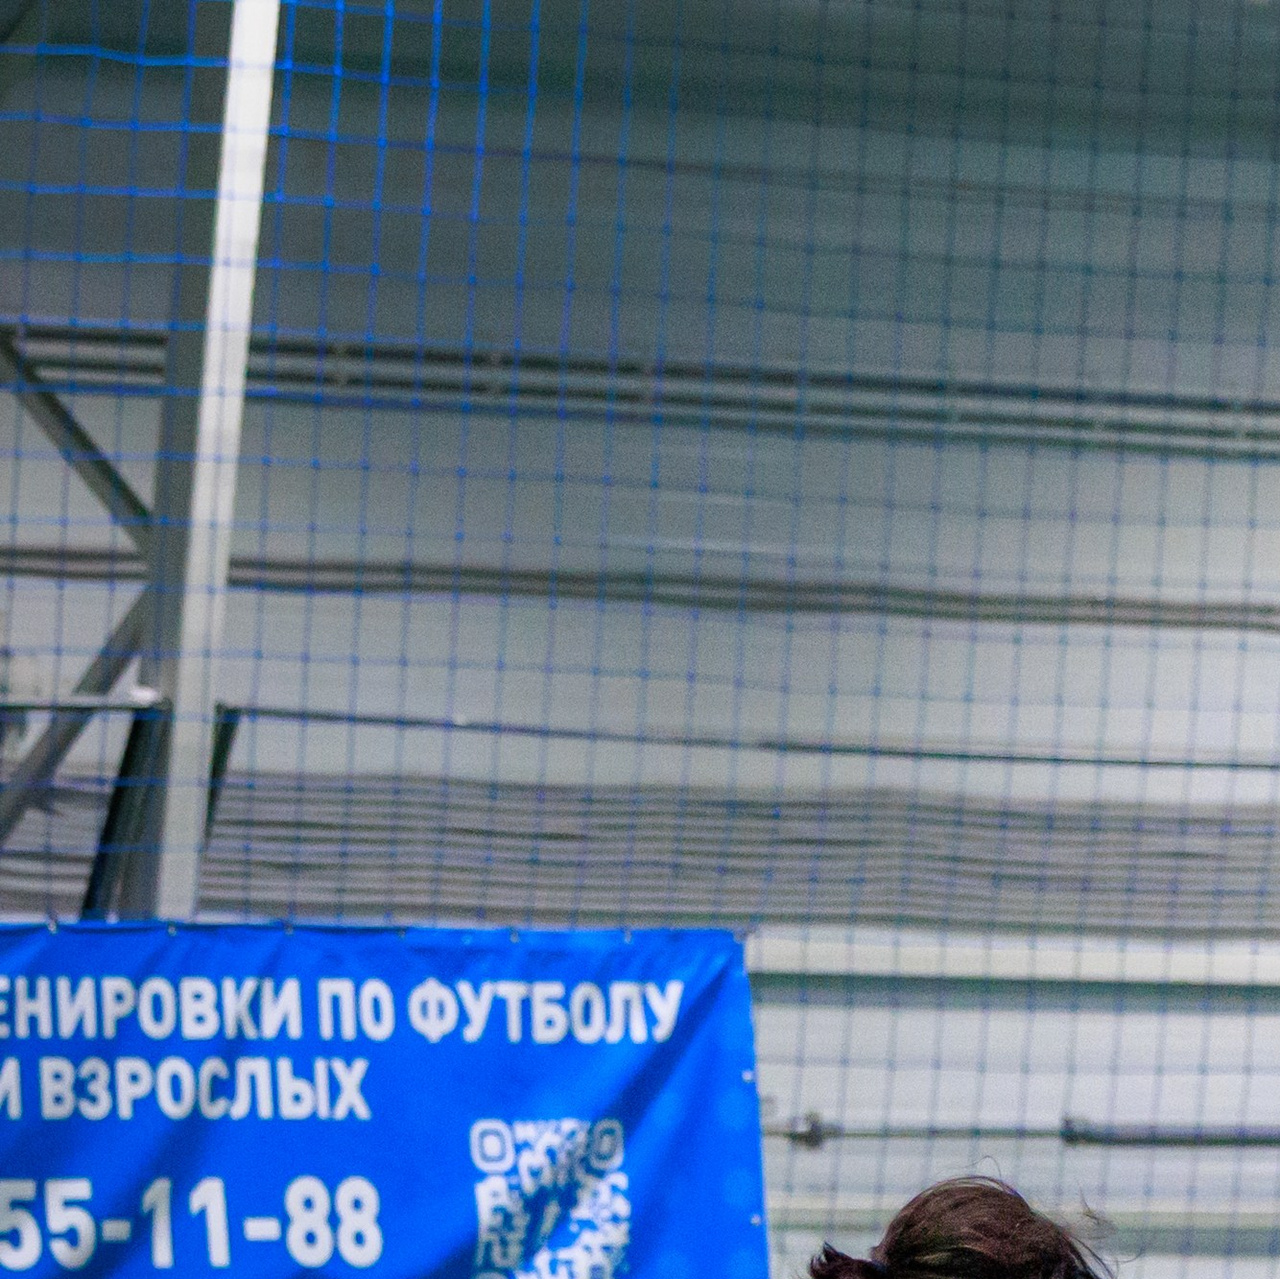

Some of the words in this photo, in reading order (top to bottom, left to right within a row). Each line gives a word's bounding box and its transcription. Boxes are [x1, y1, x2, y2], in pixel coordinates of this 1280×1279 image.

[319, 978, 395, 1041] ПО
[408, 978, 684, 1044] ФУТБОЛУ
[39, 1056, 372, 1121] ВЗРОСЛЫХ
